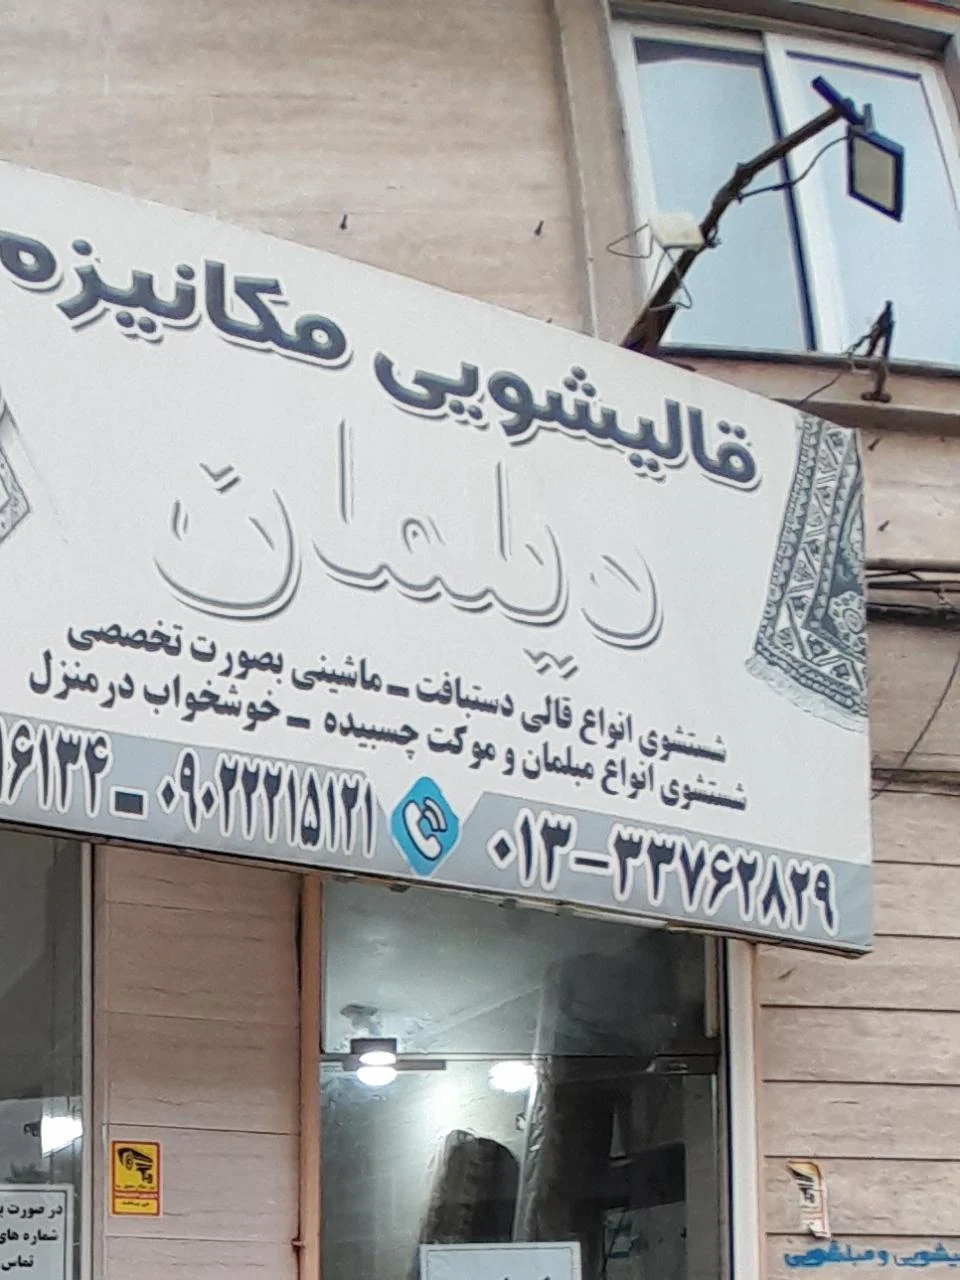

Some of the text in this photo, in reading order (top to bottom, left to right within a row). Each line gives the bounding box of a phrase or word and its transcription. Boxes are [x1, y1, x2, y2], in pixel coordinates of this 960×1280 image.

[374, 350, 761, 491] قالیشویی
[68, 620, 182, 656] تخصصی
[190, 634, 285, 679] بصورت
[29, 651, 101, 699] منزل
[292, 654, 383, 694] ماشینی
[416, 671, 514, 719] دستبافت
[143, 674, 281, 730] خوشخواب
[521, 691, 573, 733] قالی
[323, 715, 420, 760] چسبیده
[427, 725, 495, 768] موکت
[579, 708, 633, 750] انواع
[640, 725, 727, 763] شستشوی
[502, 748, 515, 776] و
[522, 740, 595, 787] مبلمان
[600, 757, 654, 799] انواع
[660, 774, 747, 812] شستشوی
[7, 1204, 44, 1218] صورت
[48, 1204, 64, 1218] در
[23, 1228, 58, 1245] شماره
[1, 1254, 34, 1271] تماس
